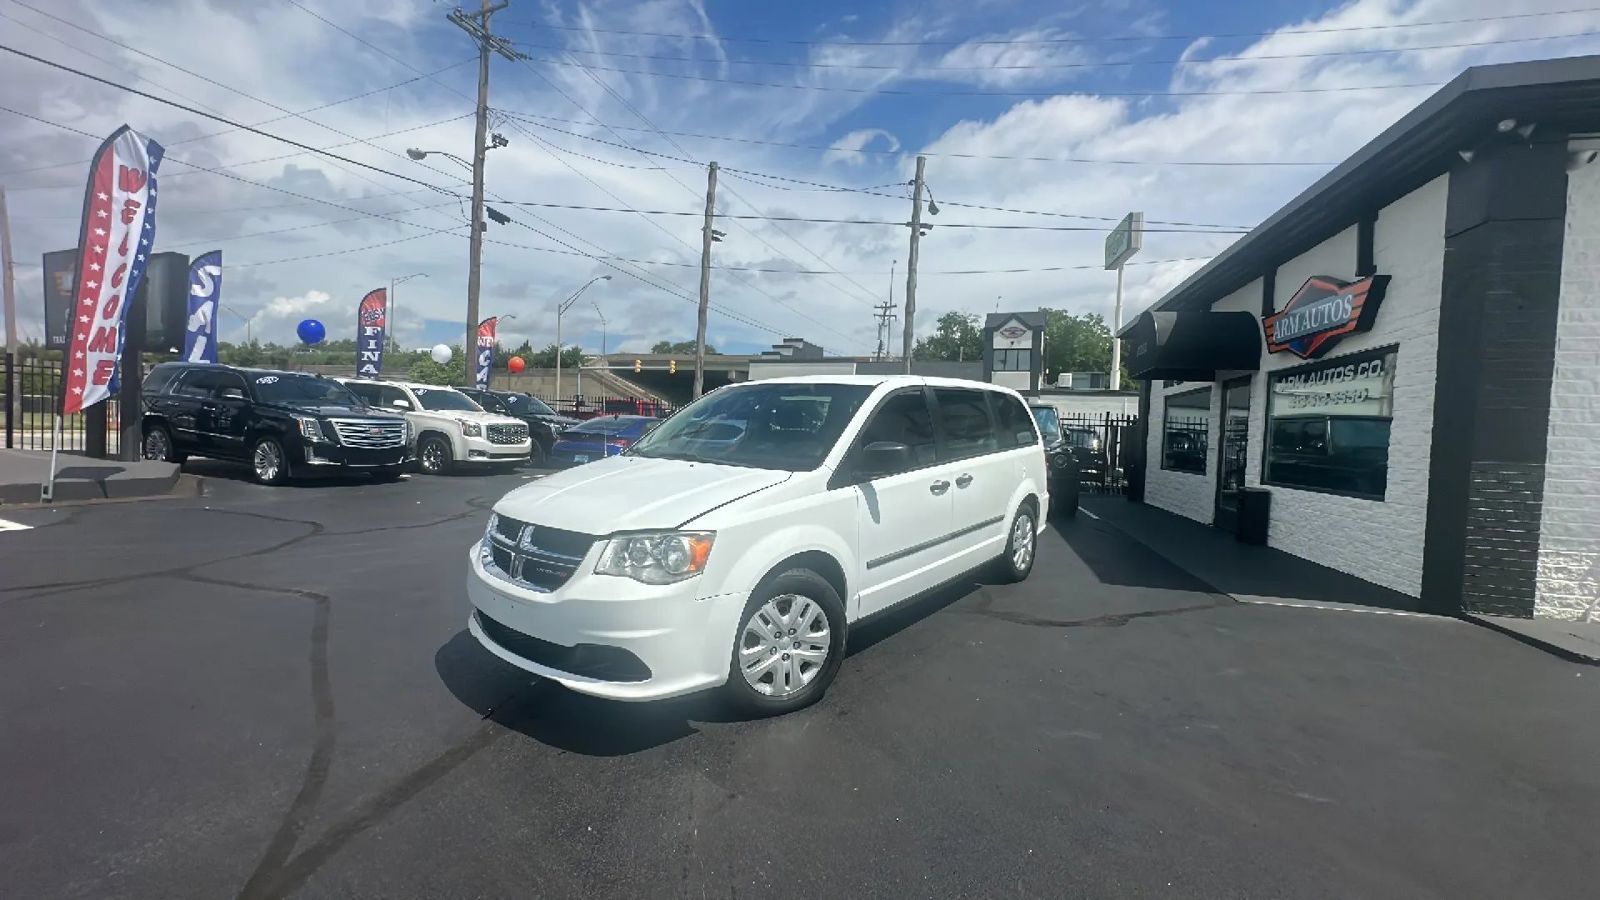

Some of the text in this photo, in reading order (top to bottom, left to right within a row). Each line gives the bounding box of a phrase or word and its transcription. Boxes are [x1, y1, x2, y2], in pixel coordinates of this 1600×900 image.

[89, 164, 147, 386] WELCOME
[187, 265, 222, 363] SAL
[1273, 294, 1353, 340] ARM AUTOS
[359, 326, 382, 376] FINA
[1307, 364, 1355, 389] AUTOS
[1357, 359, 1384, 379] CO.
